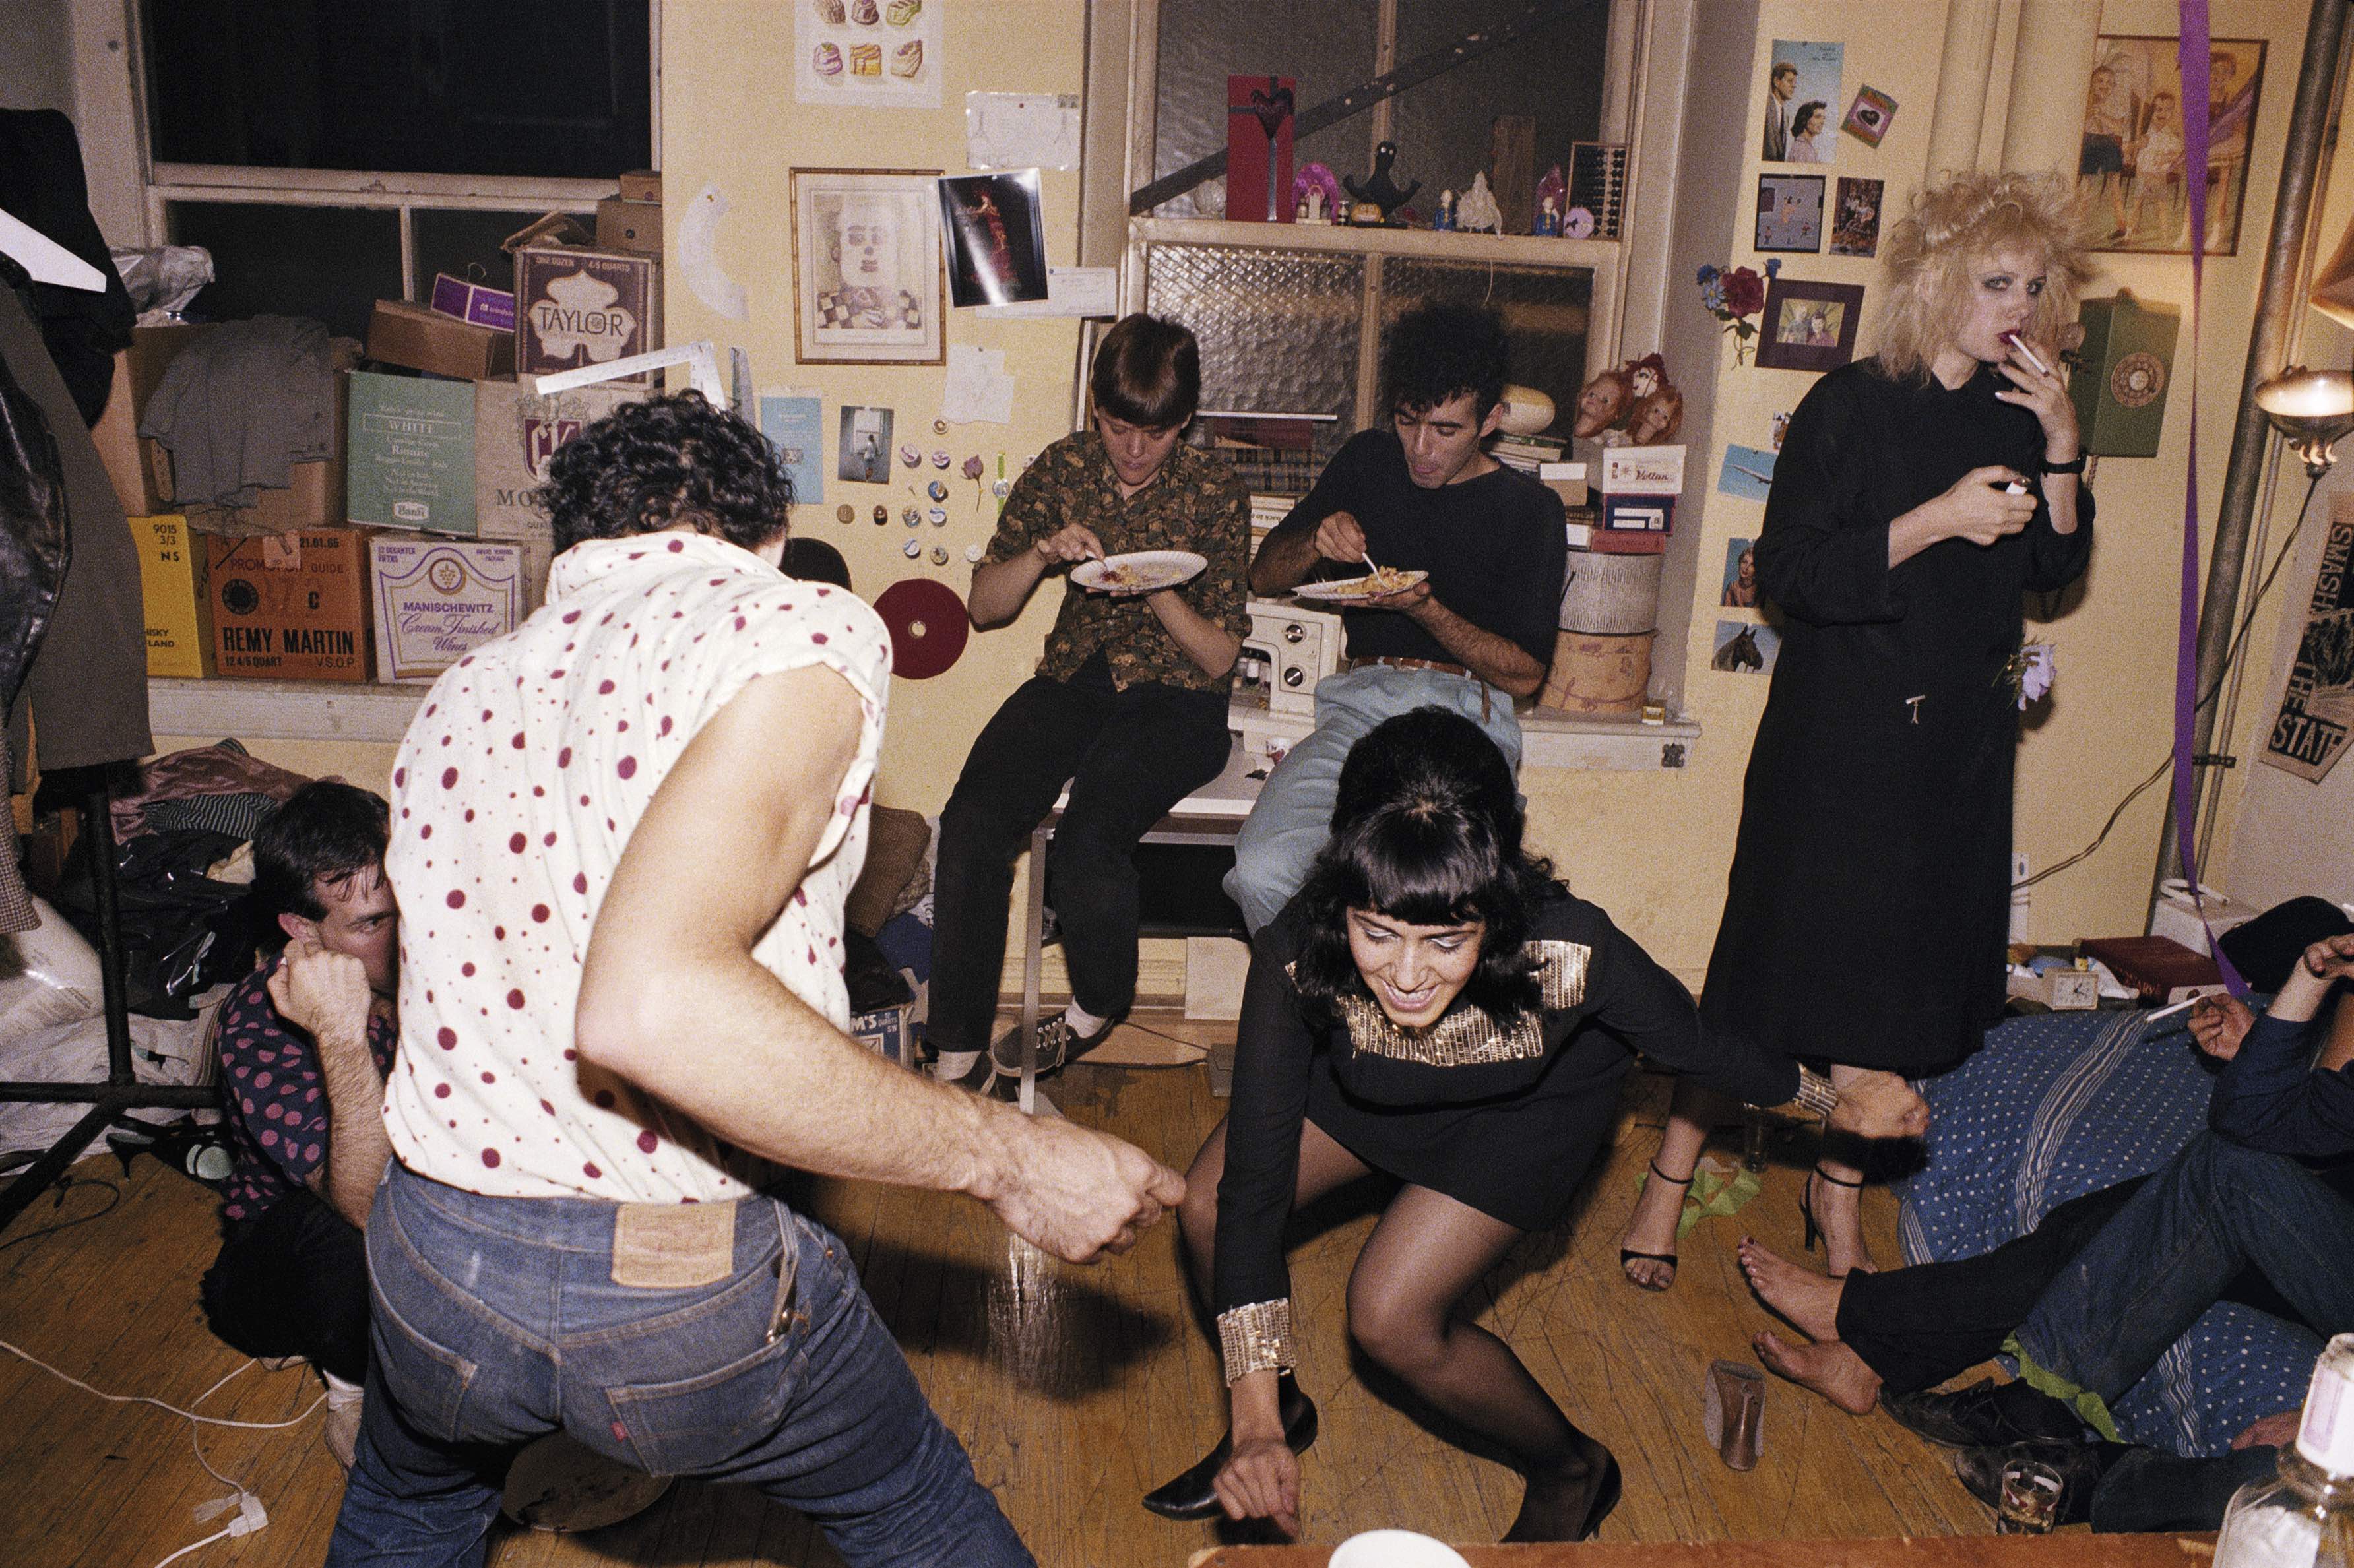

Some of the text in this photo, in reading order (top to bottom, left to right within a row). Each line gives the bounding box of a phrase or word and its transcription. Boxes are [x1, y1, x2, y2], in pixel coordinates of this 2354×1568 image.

[538, 306, 623, 337] TAYLOR
[388, 420, 434, 435] WHITE
[153, 524, 177, 534] 9015
[160, 535, 176, 546] 3/3
[311, 563, 344, 574] GUIDE
[307, 591, 320, 610] C
[403, 602, 493, 613] MANISCHEWITZ
[397, 612, 501, 636] Cream Finished
[148, 639, 175, 648] LAND
[222, 627, 354, 655] REMY MARTIN
[433, 636, 468, 652] Wines
[850, 1014, 877, 1032] M'S
